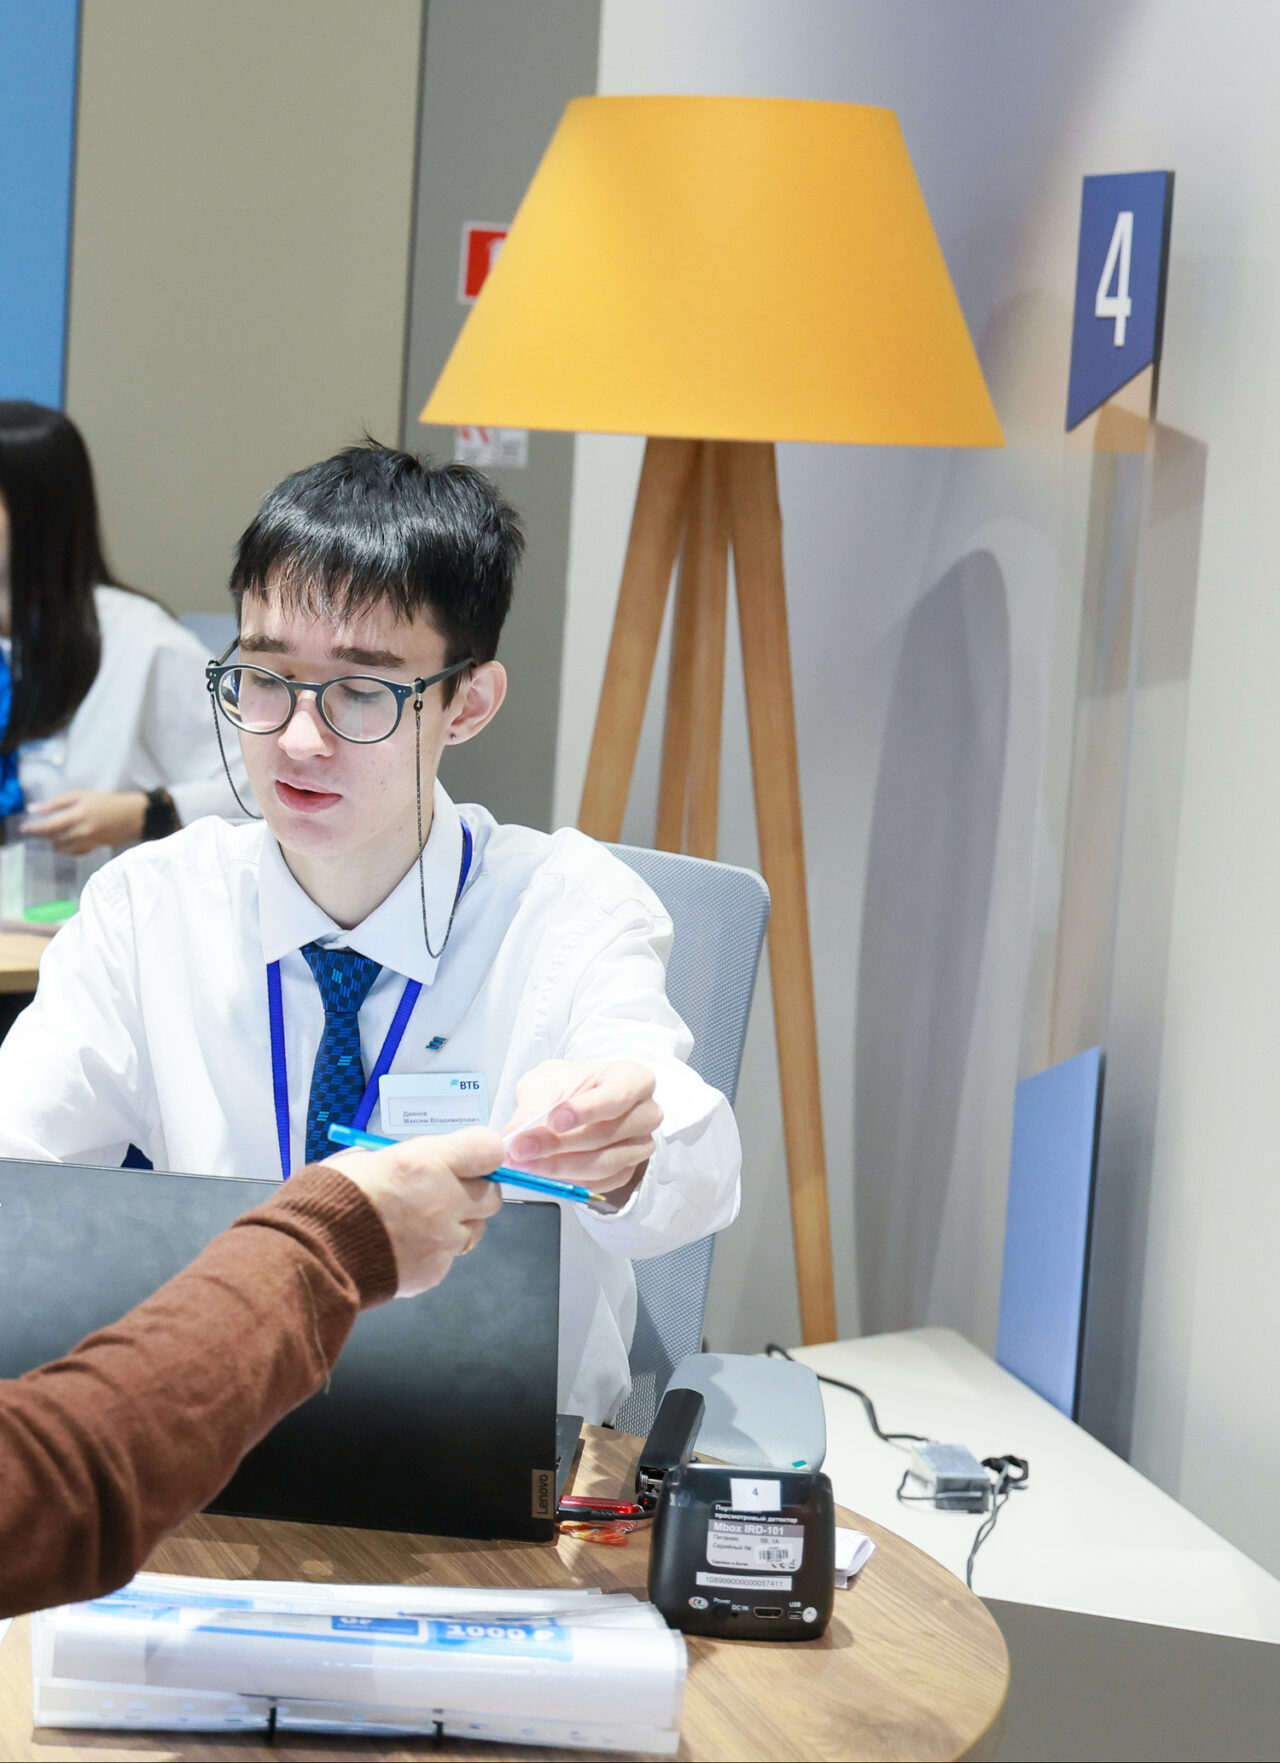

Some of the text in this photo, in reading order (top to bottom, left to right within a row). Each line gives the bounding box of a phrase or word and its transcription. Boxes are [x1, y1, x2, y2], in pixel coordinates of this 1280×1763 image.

[1095, 211, 1134, 347] 4
[460, 1080, 480, 1090] ВТБ
[536, 1474, 549, 1514] Lenovo
[752, 1487, 759, 1496] 4
[715, 1513, 798, 1524] просмотровый детектор
[713, 1521, 784, 1536] Mbox IRD-101
[445, 1623, 526, 1640] 1000
